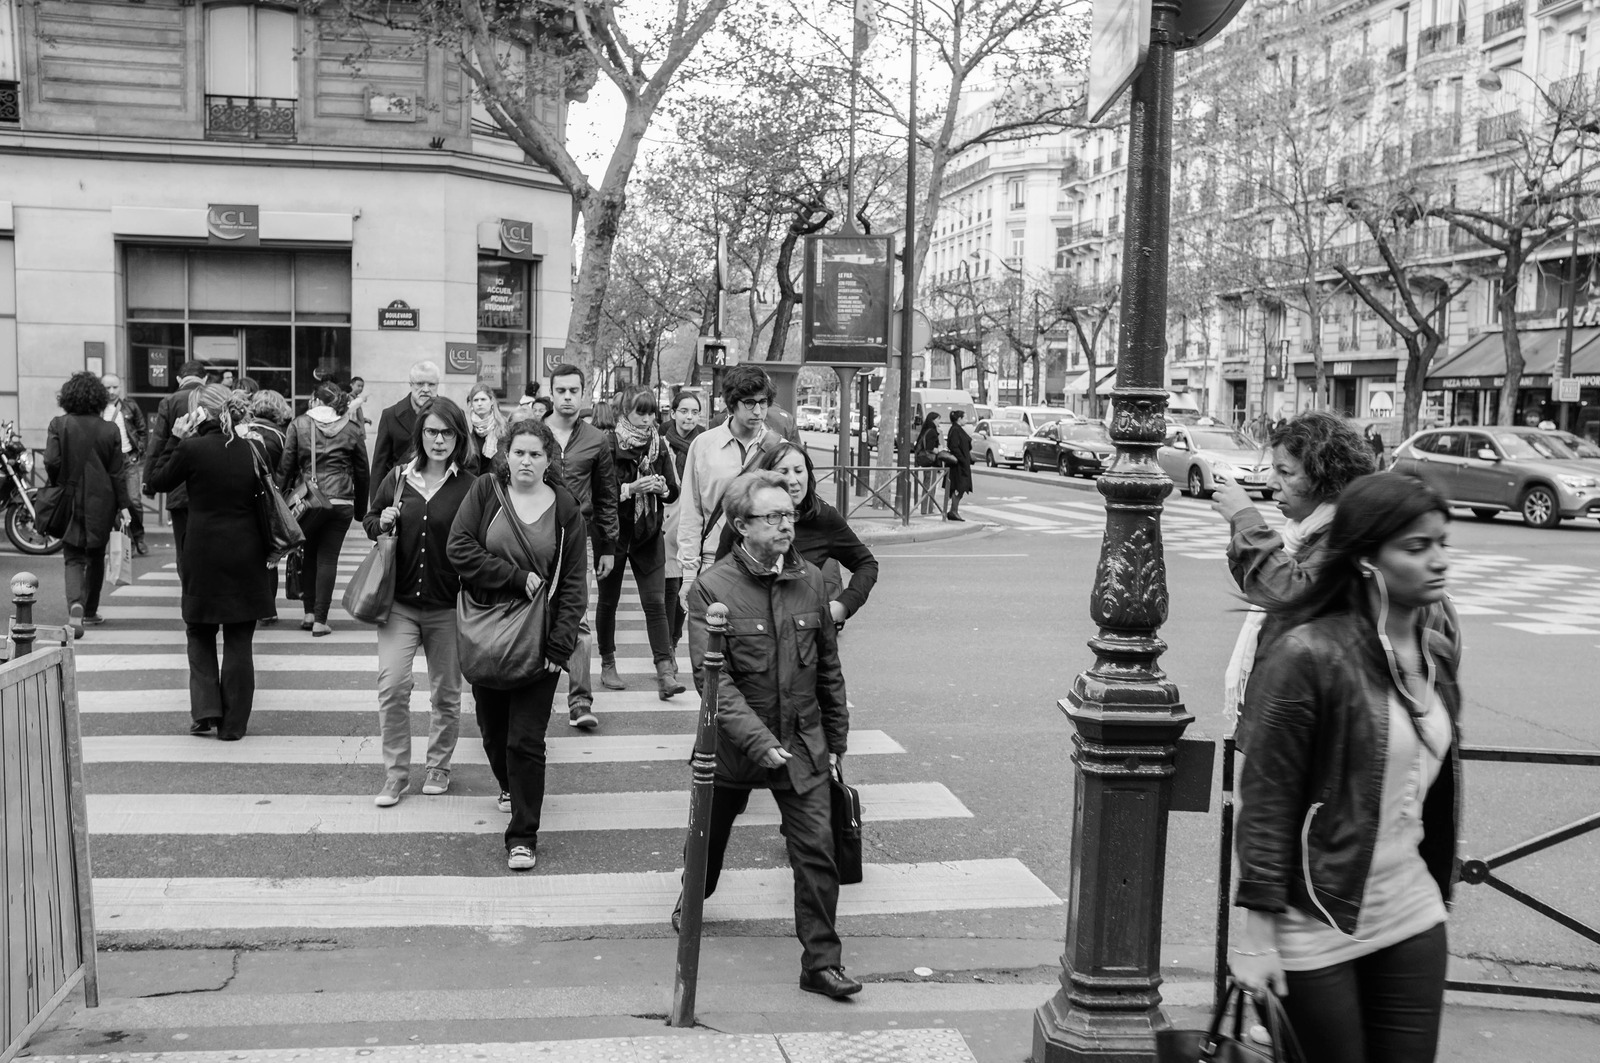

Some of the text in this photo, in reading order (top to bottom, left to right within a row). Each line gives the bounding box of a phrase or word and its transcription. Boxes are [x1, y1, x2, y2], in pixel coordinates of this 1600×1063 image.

[209, 209, 253, 226] LCL
[503, 225, 530, 241] LCL
[495, 278, 504, 286] ICI
[486, 286, 513, 295] ACCUEIL
[490, 295, 509, 303] POINT
[484, 303, 515, 312] ETUDIANT
[1557, 304, 1600, 327] PZZ
[451, 349, 473, 360] LCL
[1333, 362, 1352, 375] DARTY
